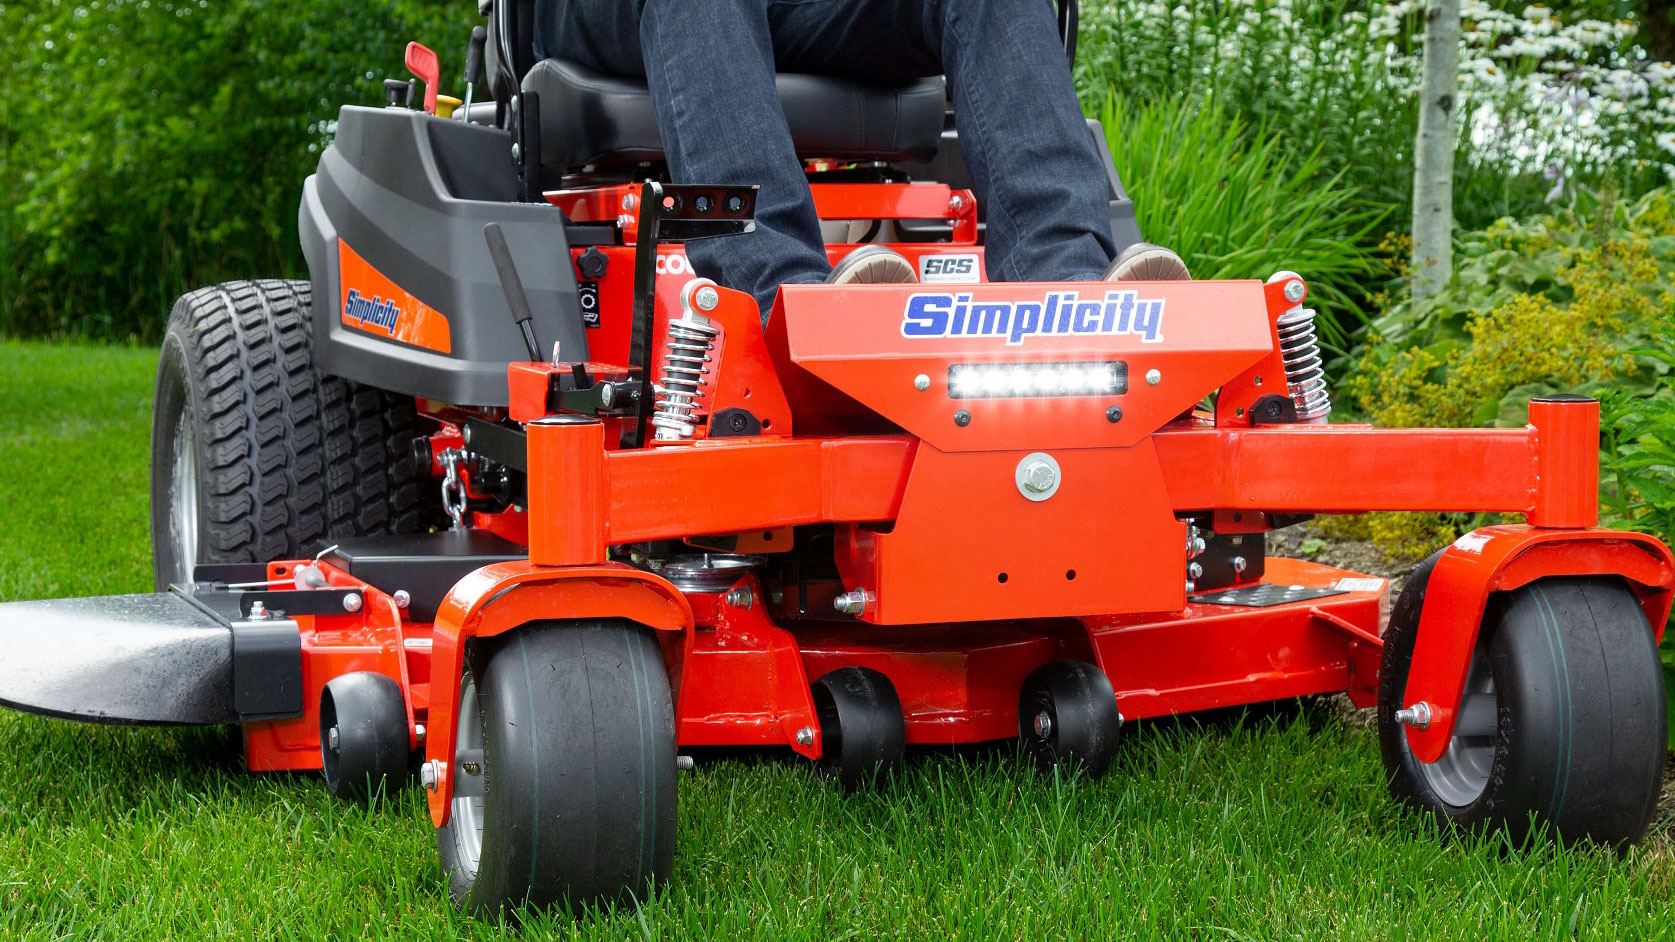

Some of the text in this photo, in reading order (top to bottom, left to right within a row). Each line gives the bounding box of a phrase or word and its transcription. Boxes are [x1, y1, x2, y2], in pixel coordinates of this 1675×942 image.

[924, 258, 974, 275] SCS
[345, 289, 399, 335] Simplicity
[901, 291, 1165, 345] Simplicity
